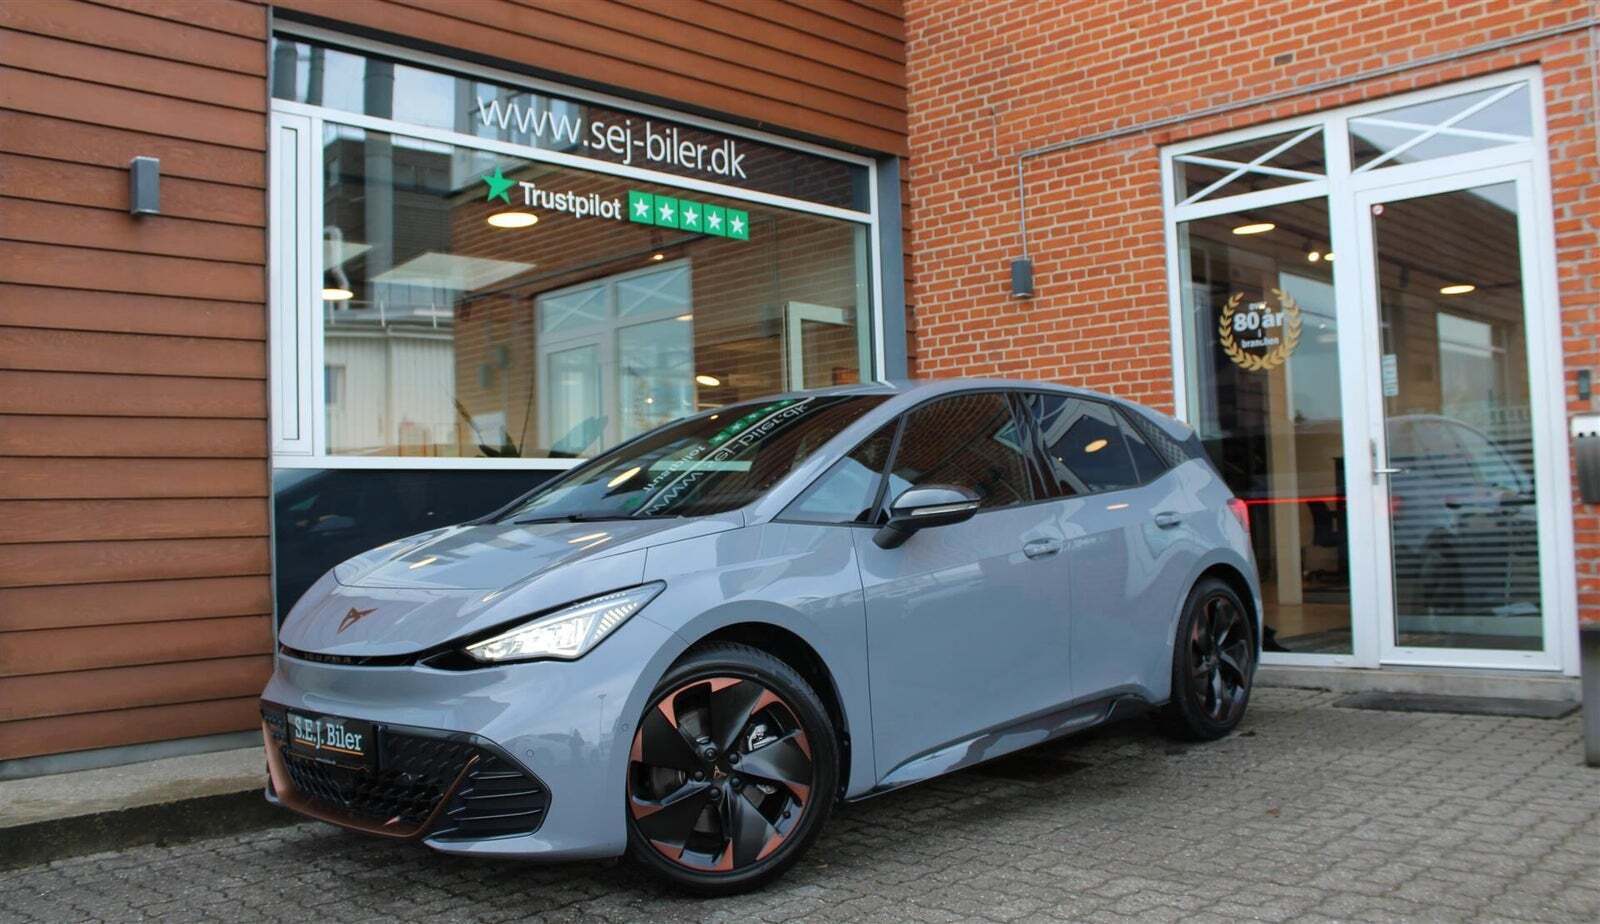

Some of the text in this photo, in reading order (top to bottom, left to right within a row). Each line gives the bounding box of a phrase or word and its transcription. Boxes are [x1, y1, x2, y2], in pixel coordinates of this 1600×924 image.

[477, 96, 747, 179] www.sej-biler.dk
[519, 181, 621, 219] Trustpilot
[1233, 307, 1284, 332] 80 år
[295, 716, 362, 751] S.E.J. Biler
